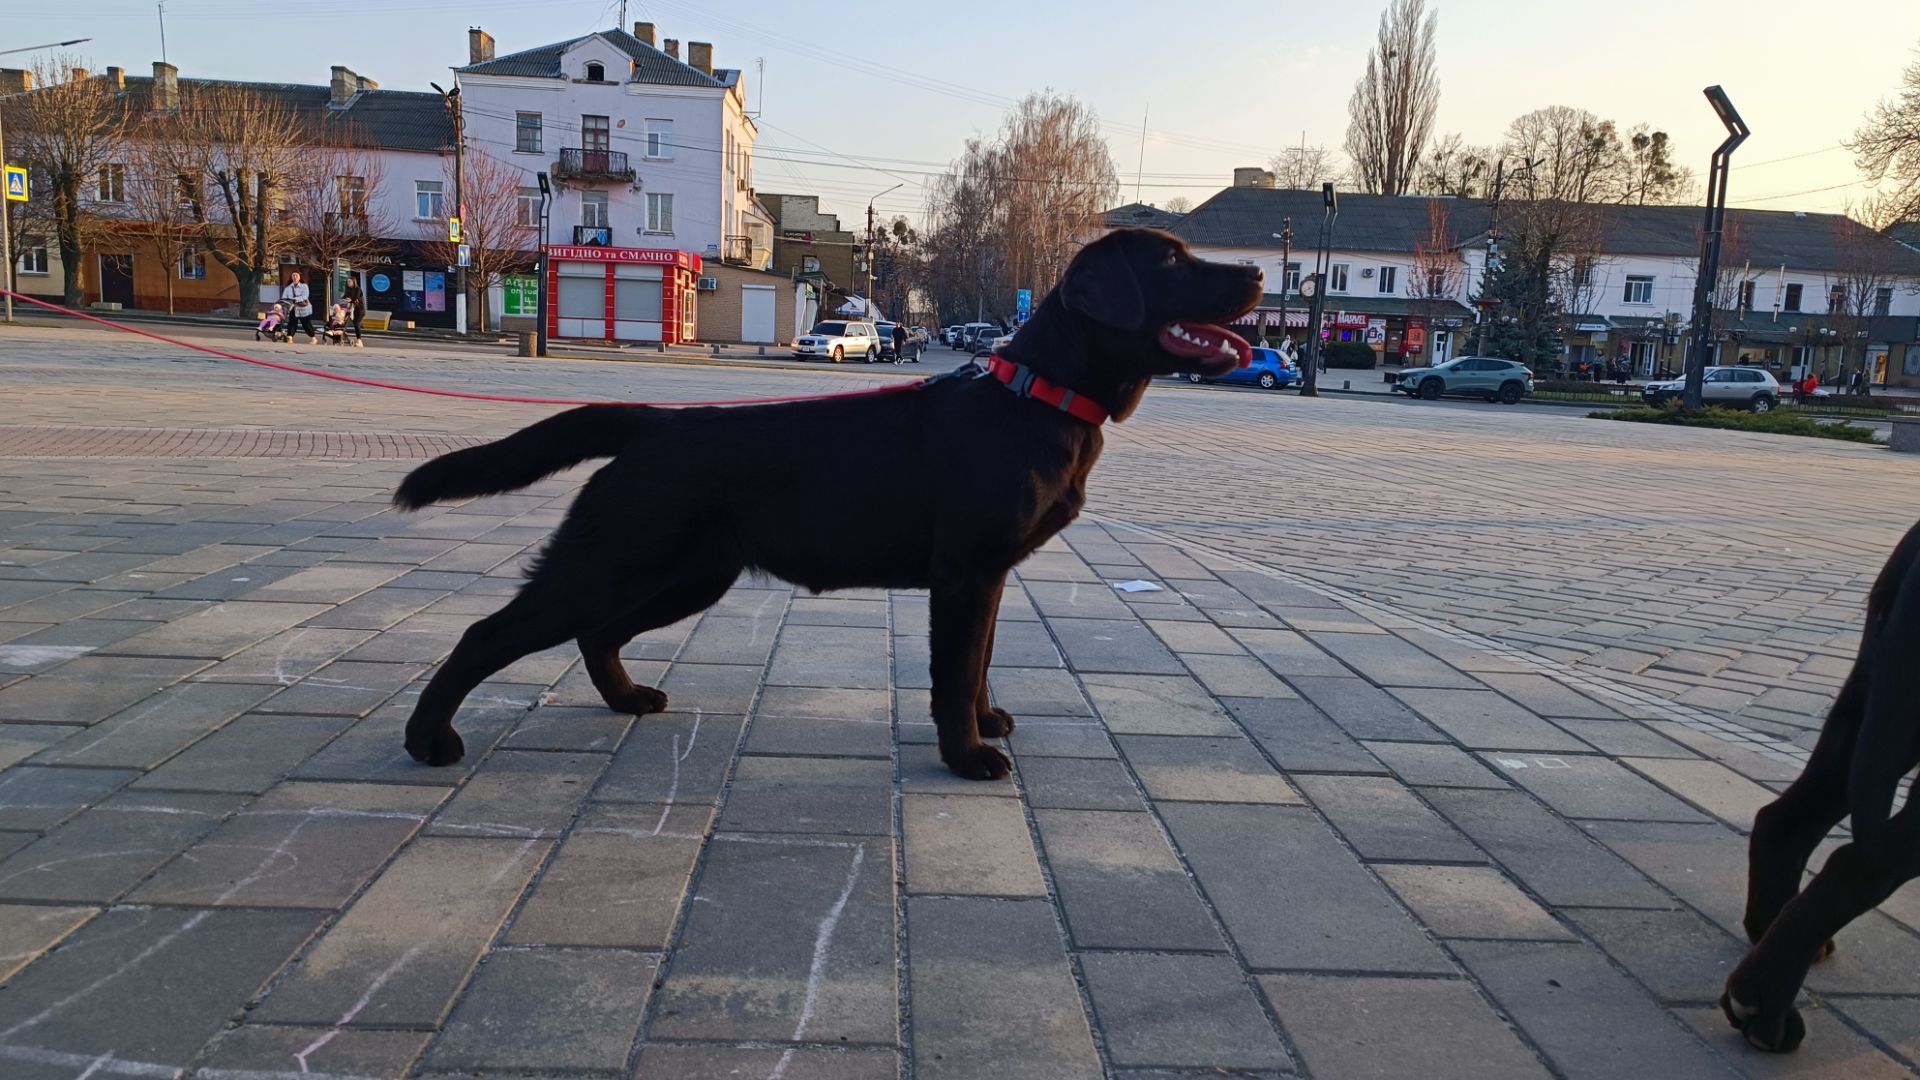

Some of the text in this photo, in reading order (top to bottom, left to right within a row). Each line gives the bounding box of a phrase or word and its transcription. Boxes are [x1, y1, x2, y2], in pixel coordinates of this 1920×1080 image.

[604, 251, 617, 260] та
[619, 250, 673, 262] СМАЧНО
[1337, 311, 1368, 325] MARVEL
